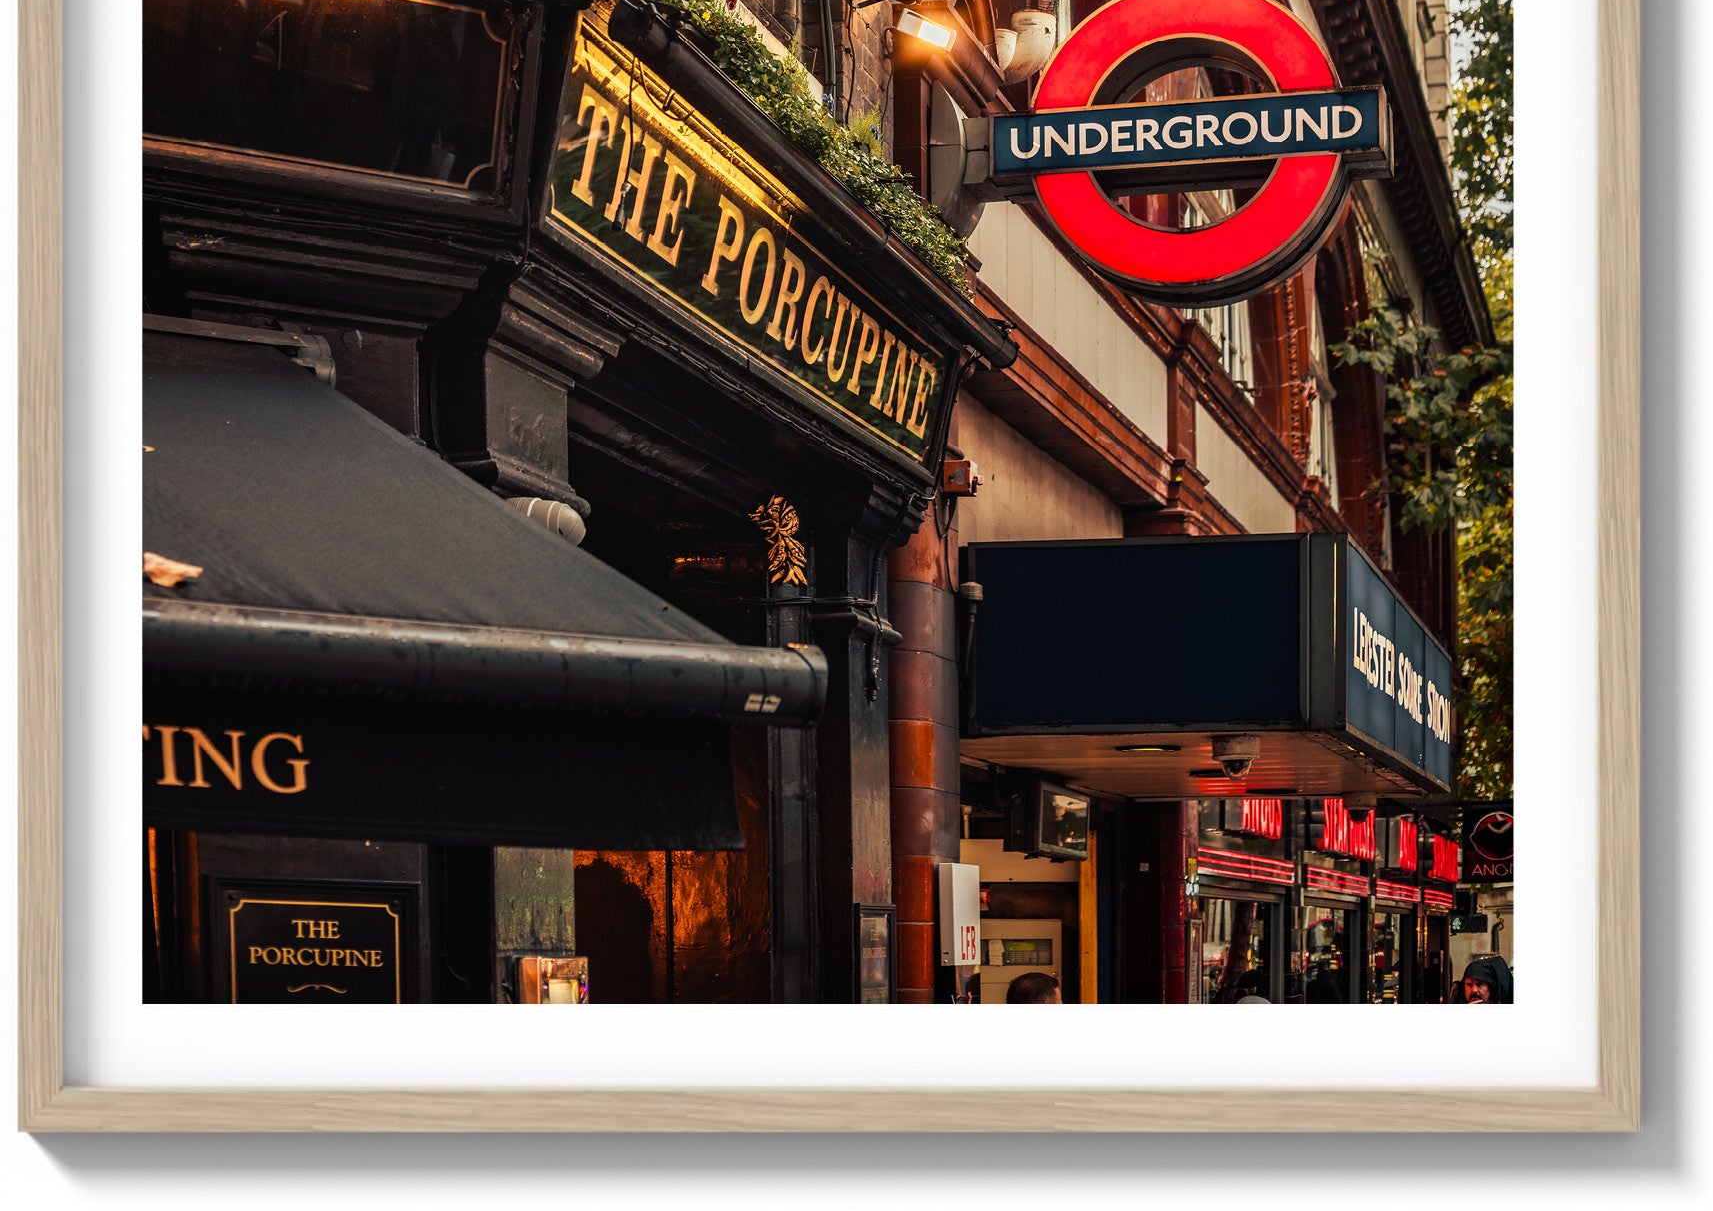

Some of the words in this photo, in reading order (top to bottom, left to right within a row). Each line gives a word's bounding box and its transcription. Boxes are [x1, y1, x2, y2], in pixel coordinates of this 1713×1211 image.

[1009, 105, 1363, 160] UNDERGROUND
[570, 82, 697, 268] THE
[700, 193, 938, 441] PORCUPINE
[142, 723, 312, 794] ING
[291, 918, 341, 940] THE
[960, 925, 977, 961] LFB
[248, 945, 384, 968] PORCUPINE
